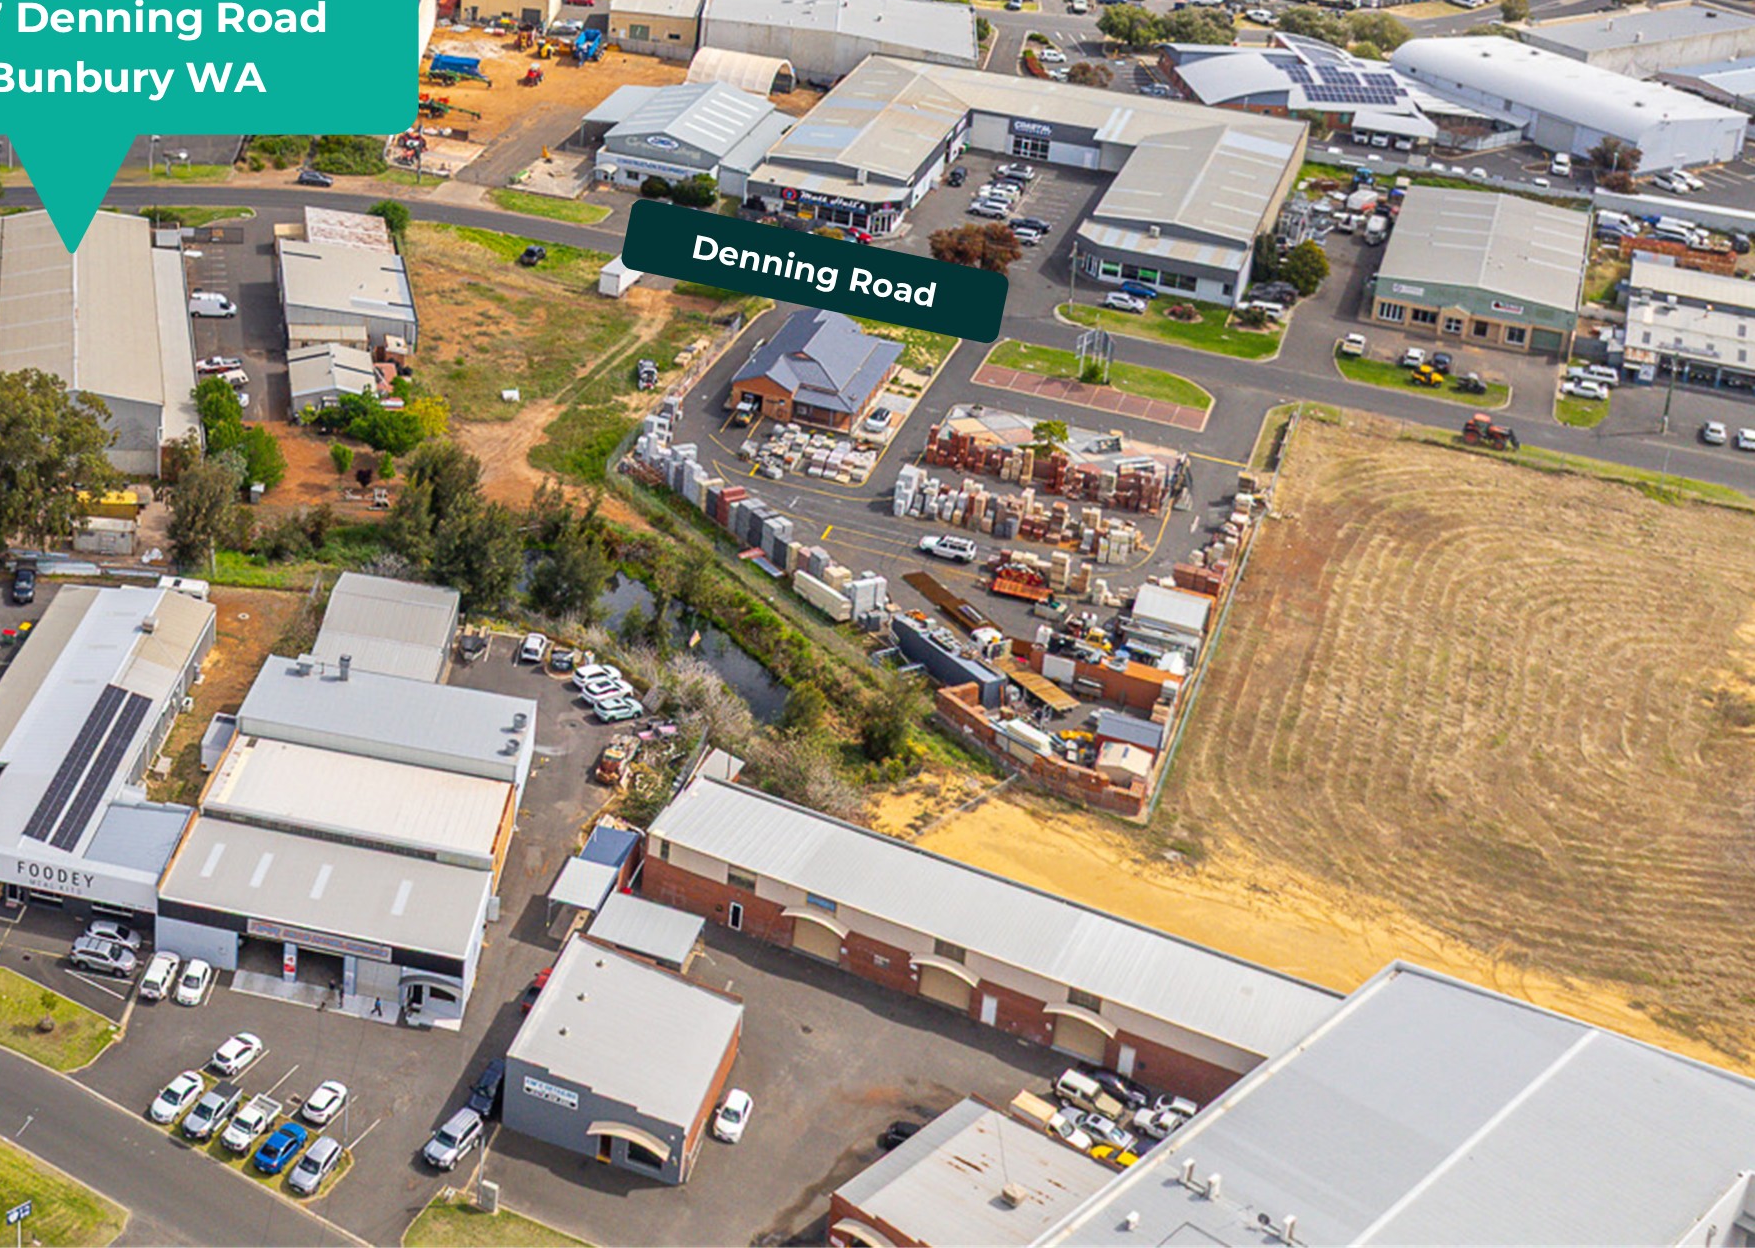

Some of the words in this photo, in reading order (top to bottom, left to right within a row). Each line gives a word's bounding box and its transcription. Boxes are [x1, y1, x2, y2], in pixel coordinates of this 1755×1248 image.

[17, 860, 95, 889] FOODEY
[29, 878, 54, 890] MEAL
[58, 884, 83, 896] KITS
